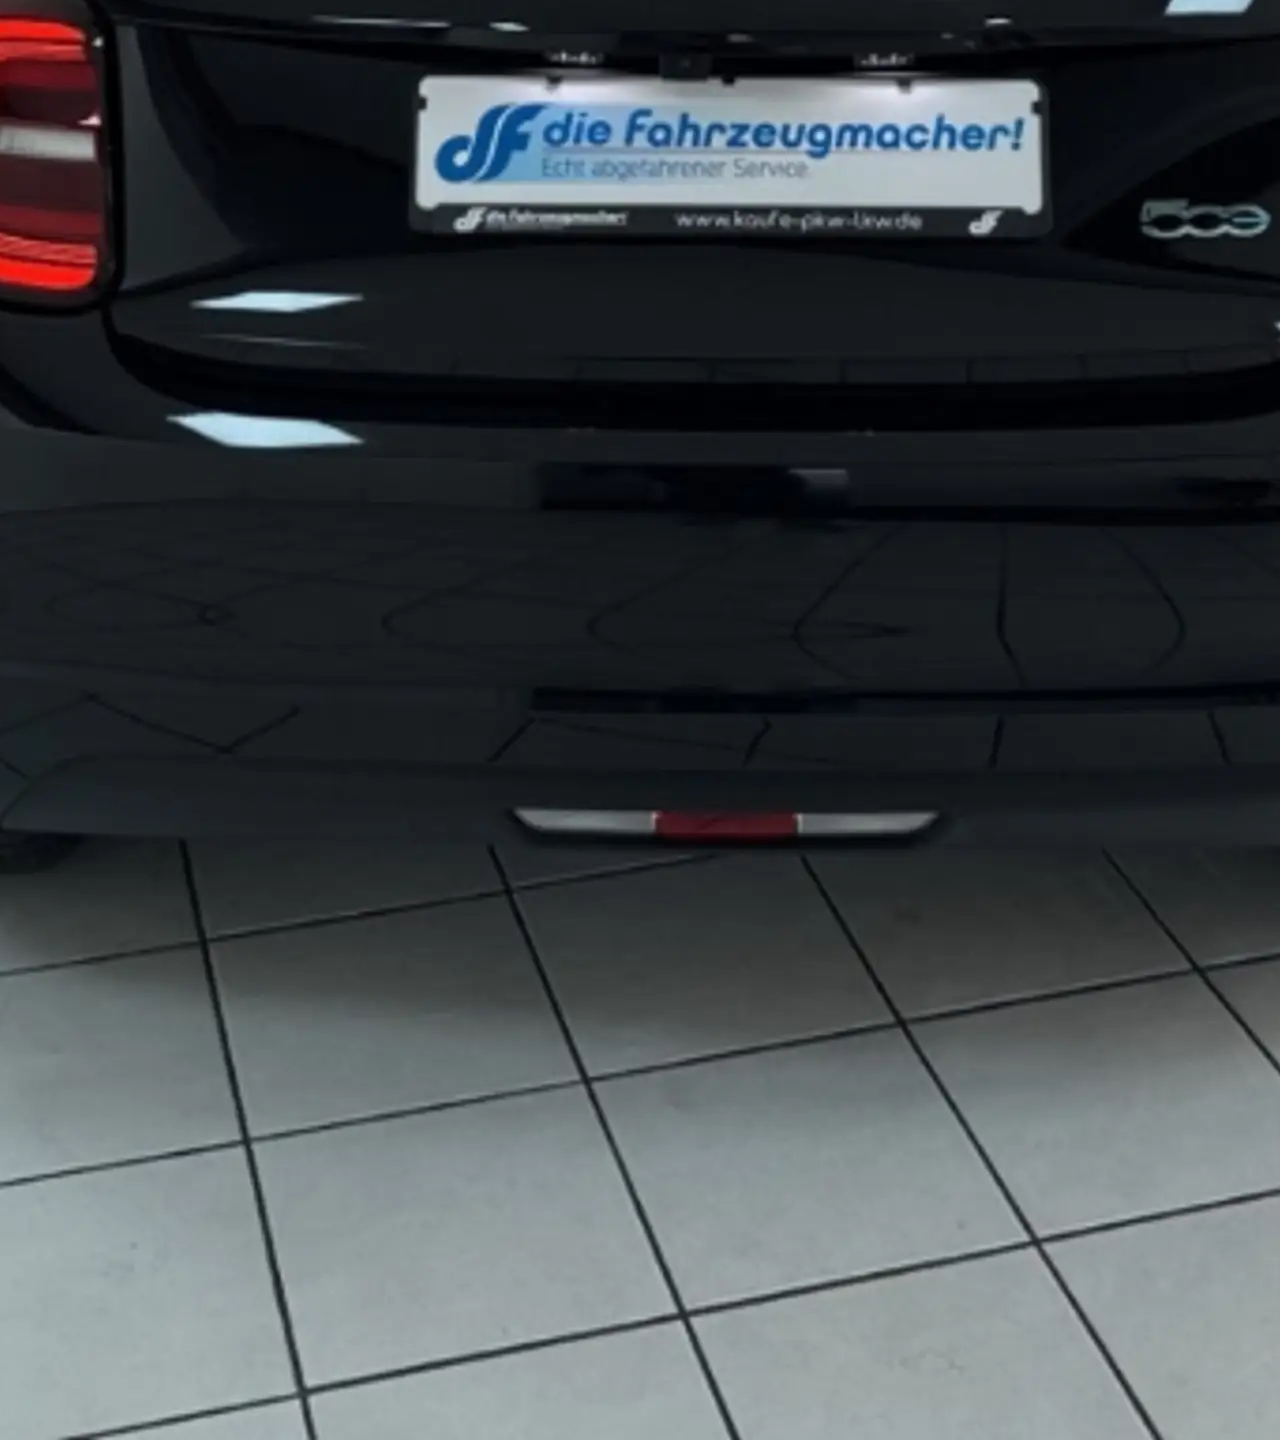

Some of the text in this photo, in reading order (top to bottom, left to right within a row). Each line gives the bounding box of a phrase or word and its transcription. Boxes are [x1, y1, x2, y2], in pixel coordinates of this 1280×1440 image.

[542, 108, 1026, 159] die Fahrzeugmacher!
[541, 157, 588, 179] Echt
[592, 157, 727, 182] abgefahrener
